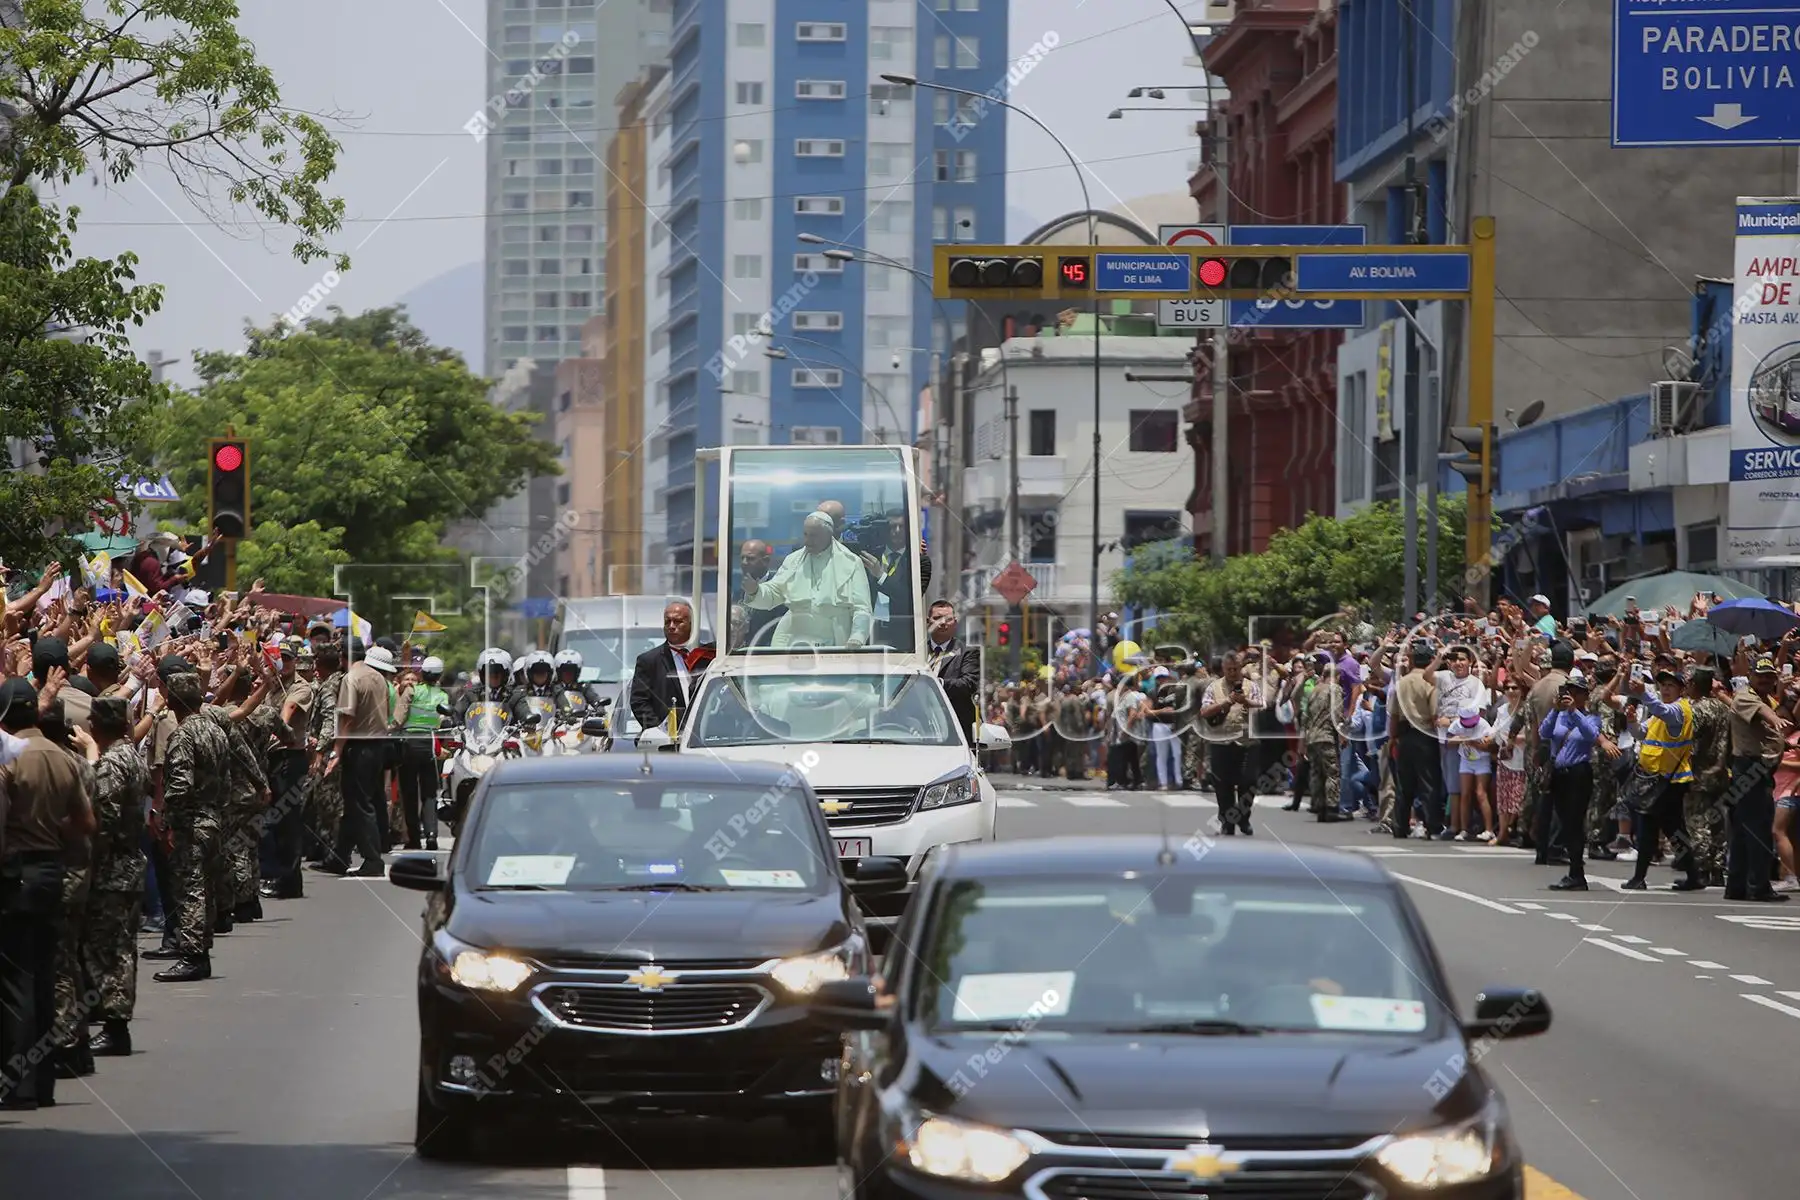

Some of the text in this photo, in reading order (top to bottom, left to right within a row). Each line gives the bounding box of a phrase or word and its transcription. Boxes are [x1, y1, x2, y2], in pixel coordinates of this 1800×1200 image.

[1662, 65, 1794, 90] BOLIVIA
[1739, 212, 1800, 230] Municipal
[1063, 264, 1084, 281] 45
[1107, 261, 1180, 271] MUNICIPALIDAD
[1349, 266, 1417, 278] AV. BOLIVIA
[1746, 257, 1800, 277] AMPL
[1123, 275, 1162, 284] DE LIMA
[1761, 282, 1792, 305] DE
[1174, 309, 1210, 323] BUS
[1740, 312, 1799, 324] HASTA AV.
[1744, 449, 1800, 470] SERVIC
[469, 705, 508, 720] POCIA
[837, 840, 862, 856] V 1
